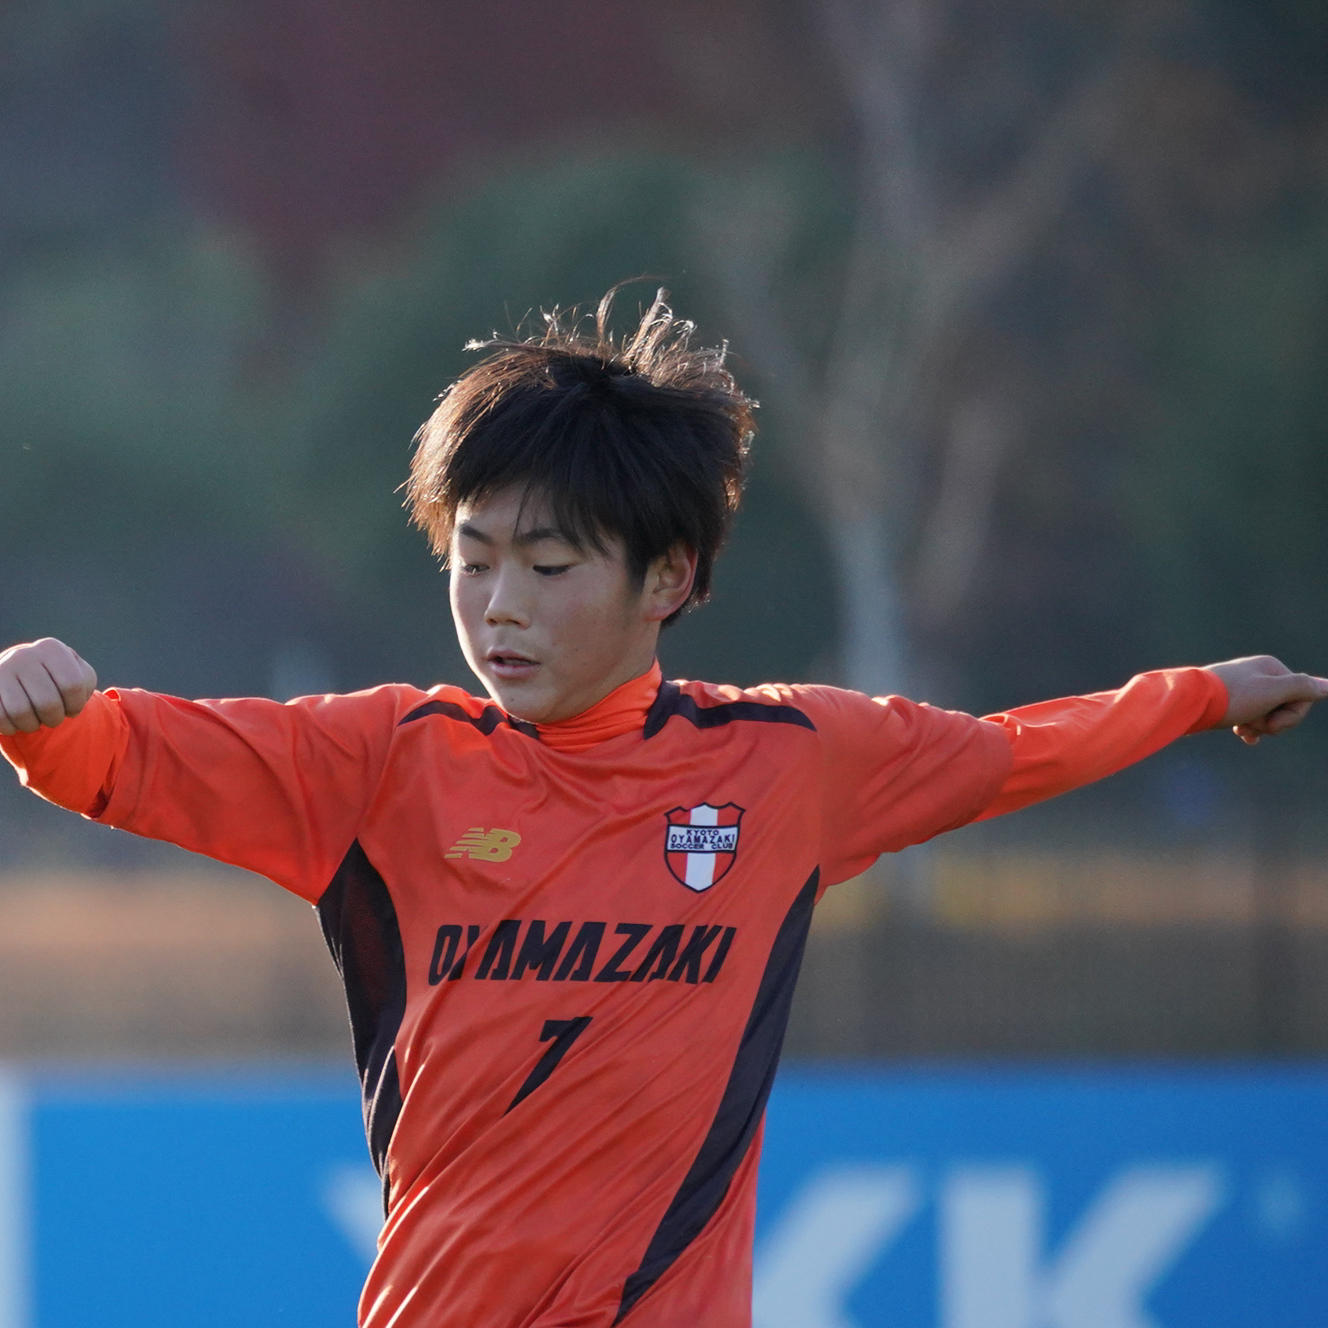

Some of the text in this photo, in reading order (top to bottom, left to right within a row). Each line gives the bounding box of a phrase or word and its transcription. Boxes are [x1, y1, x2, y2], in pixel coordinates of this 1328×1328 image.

[670, 834, 735, 844] OYAMAZAKI
[427, 920, 738, 987] OYAMAZAKI
[504, 1016, 593, 1117] 7
